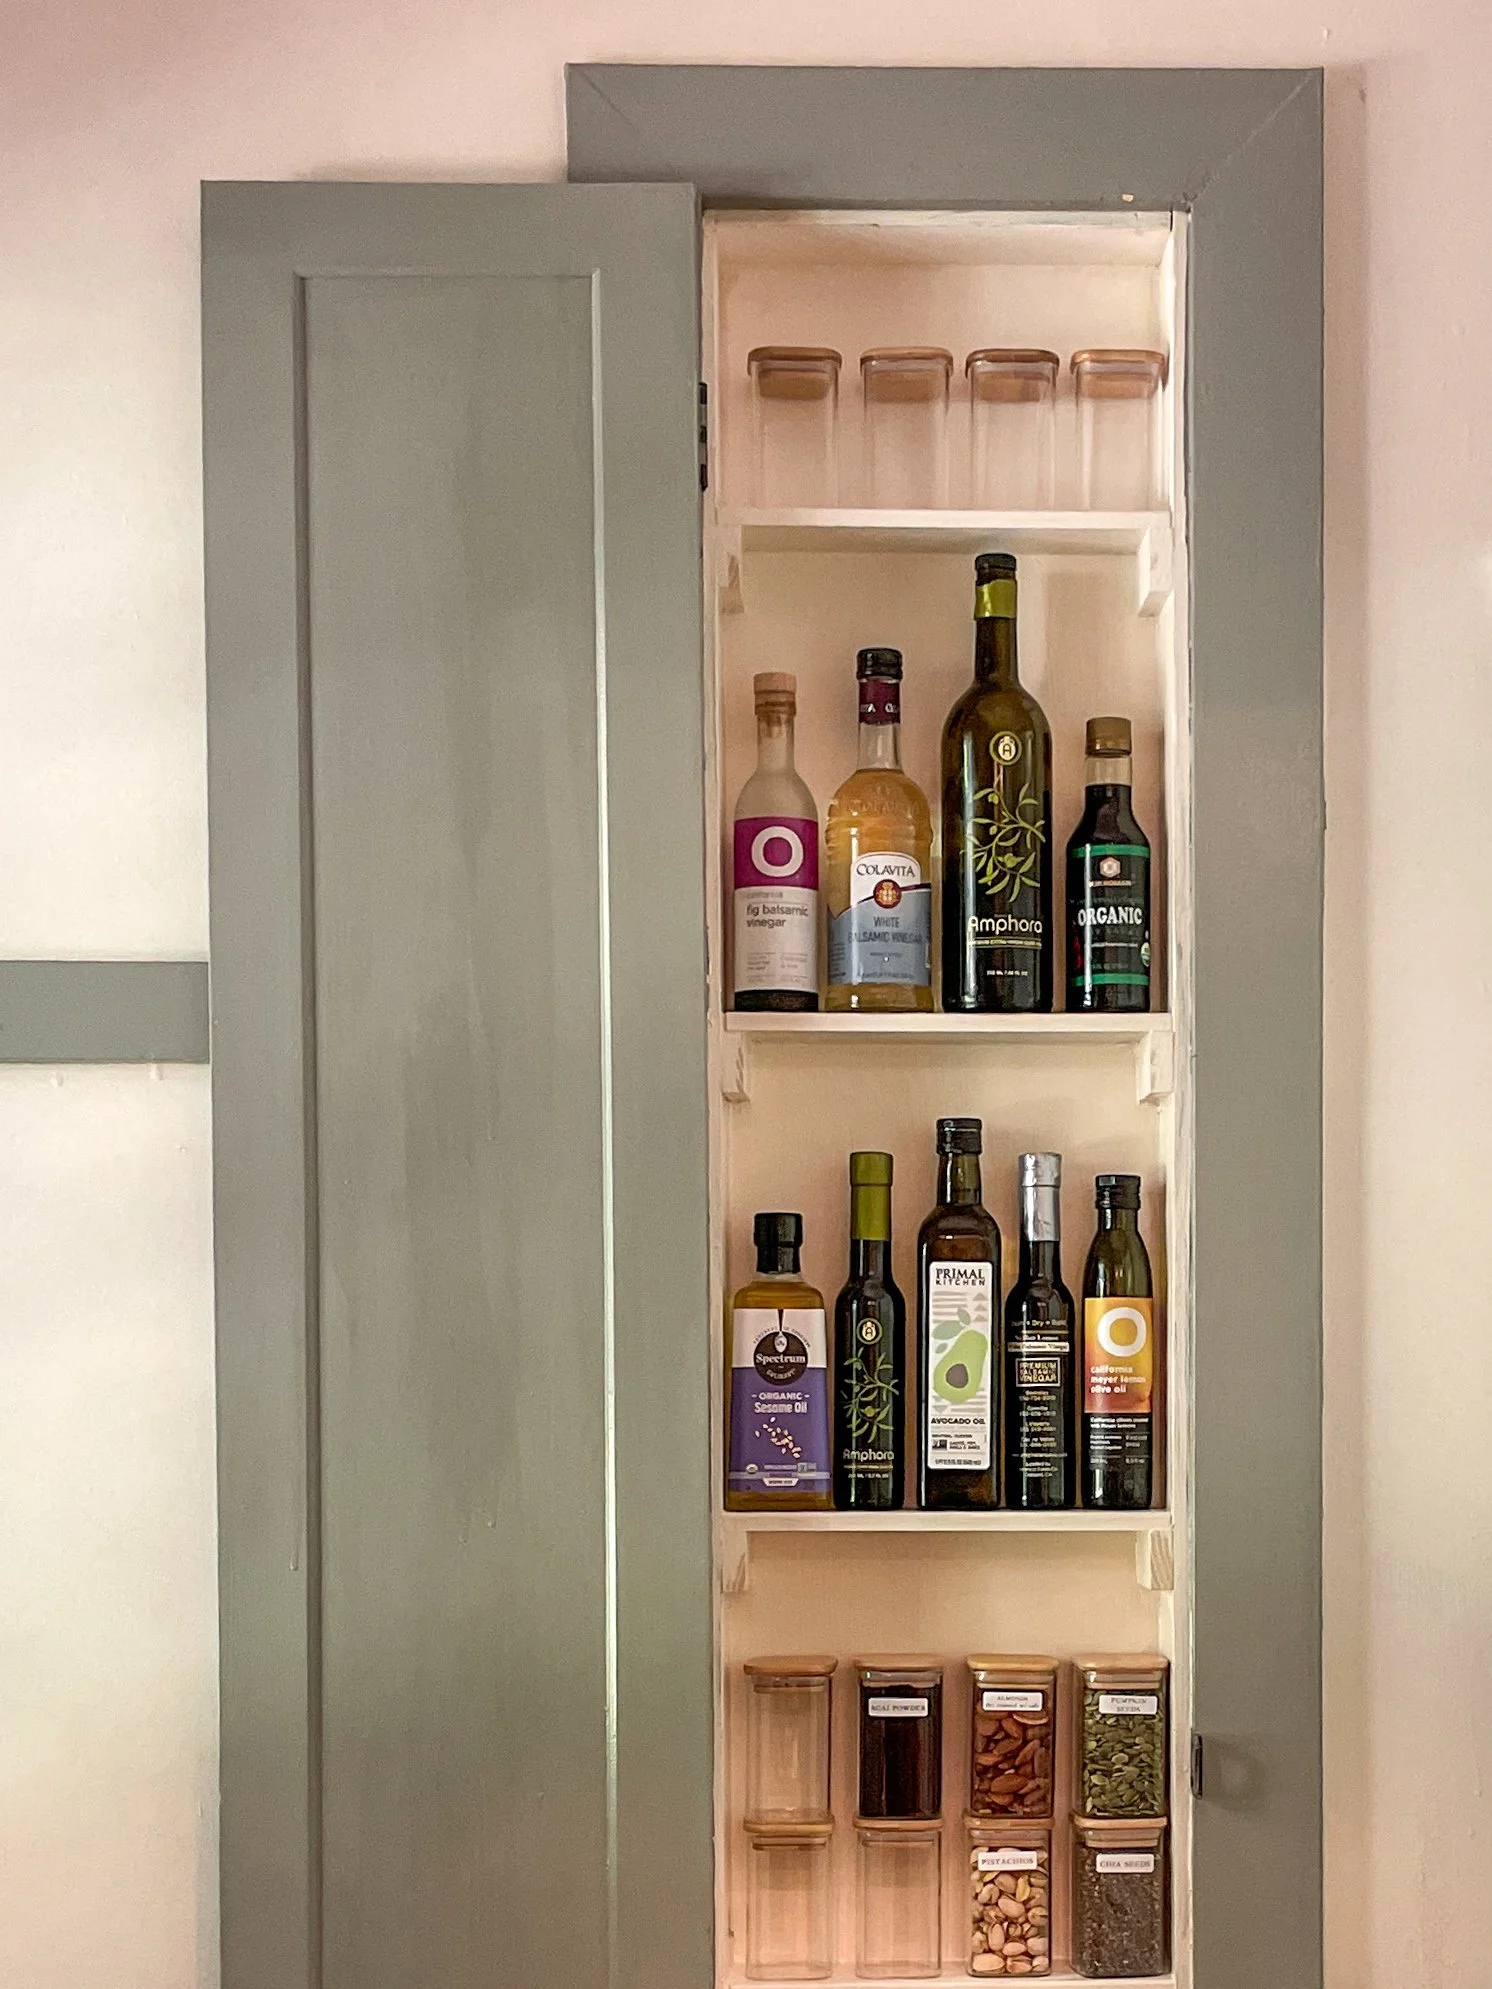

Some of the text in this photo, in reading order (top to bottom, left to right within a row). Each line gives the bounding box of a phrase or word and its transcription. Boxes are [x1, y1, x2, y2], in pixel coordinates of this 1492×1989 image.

[856, 863, 916, 878] COLAVITA
[746, 904, 808, 916] fig balsamic
[1077, 906, 1143, 926] ORGANIC
[746, 918, 786, 929] vinegar
[873, 916, 900, 928] WHITE
[968, 914, 1042, 935] Amphora
[847, 932, 923, 945] BALSAMIC VINEGAR
[936, 1268, 985, 1279] PRIMAL
[756, 1353, 806, 1365] Spectrum
[1090, 1364, 1133, 1374] california
[1019, 1374, 1057, 1382] VINEGAR
[1090, 1375, 1146, 1385] meyer lemon
[1090, 1384, 1127, 1394] olive oil
[759, 1392, 803, 1400] ORGANIC
[754, 1402, 807, 1413] Sesame Oil
[842, 1449, 895, 1463] Amphora
[981, 1857, 1034, 1865] PISTACHIOS
[1099, 1860, 1151, 1868] CHIA SEEDS
